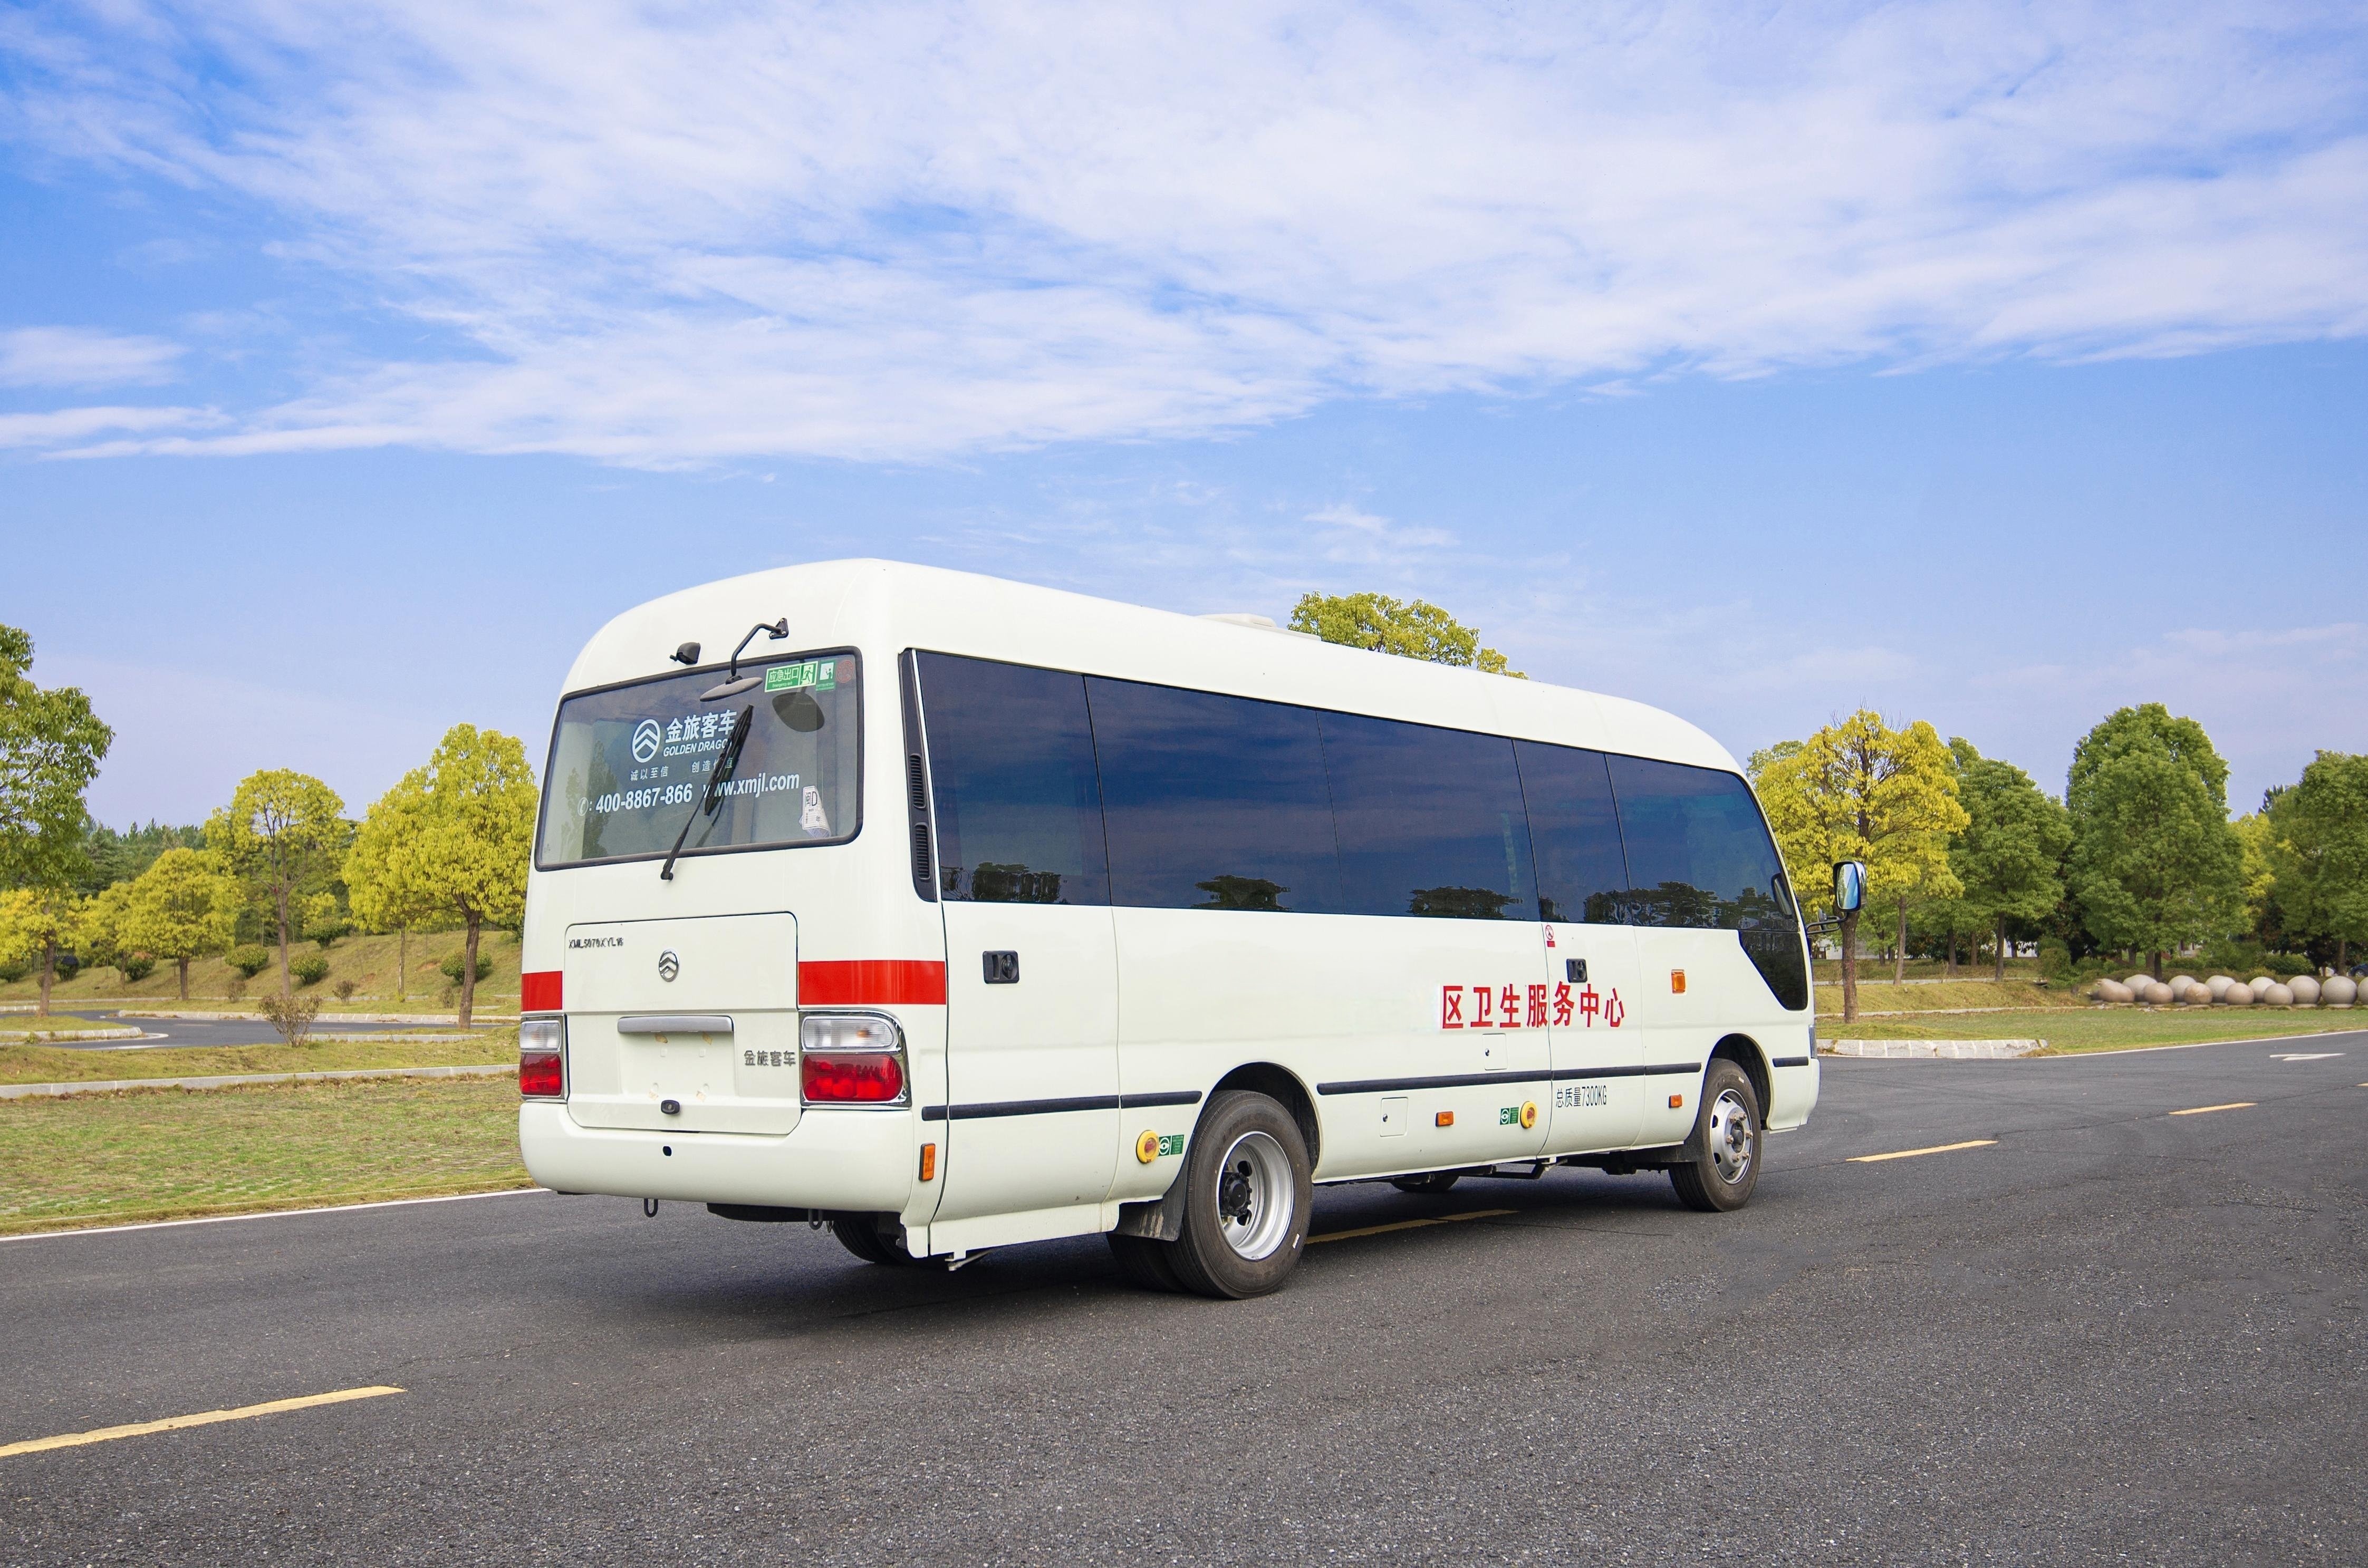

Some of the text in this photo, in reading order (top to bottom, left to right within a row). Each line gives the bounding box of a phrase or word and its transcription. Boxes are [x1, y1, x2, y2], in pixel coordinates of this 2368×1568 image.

[768, 667, 799, 683] 应急出口
[665, 709, 737, 743] 金旅客车
[663, 739, 731, 757] GOLDEN DRAGO
[630, 766, 669, 782] 诚以至信
[595, 783, 693, 814] 400-8867-866
[1442, 981, 1625, 1029] 区卫生服务中心
[744, 1050, 796, 1067] 金旅客车
[1556, 1085, 1607, 1108] 总质量7300KG
